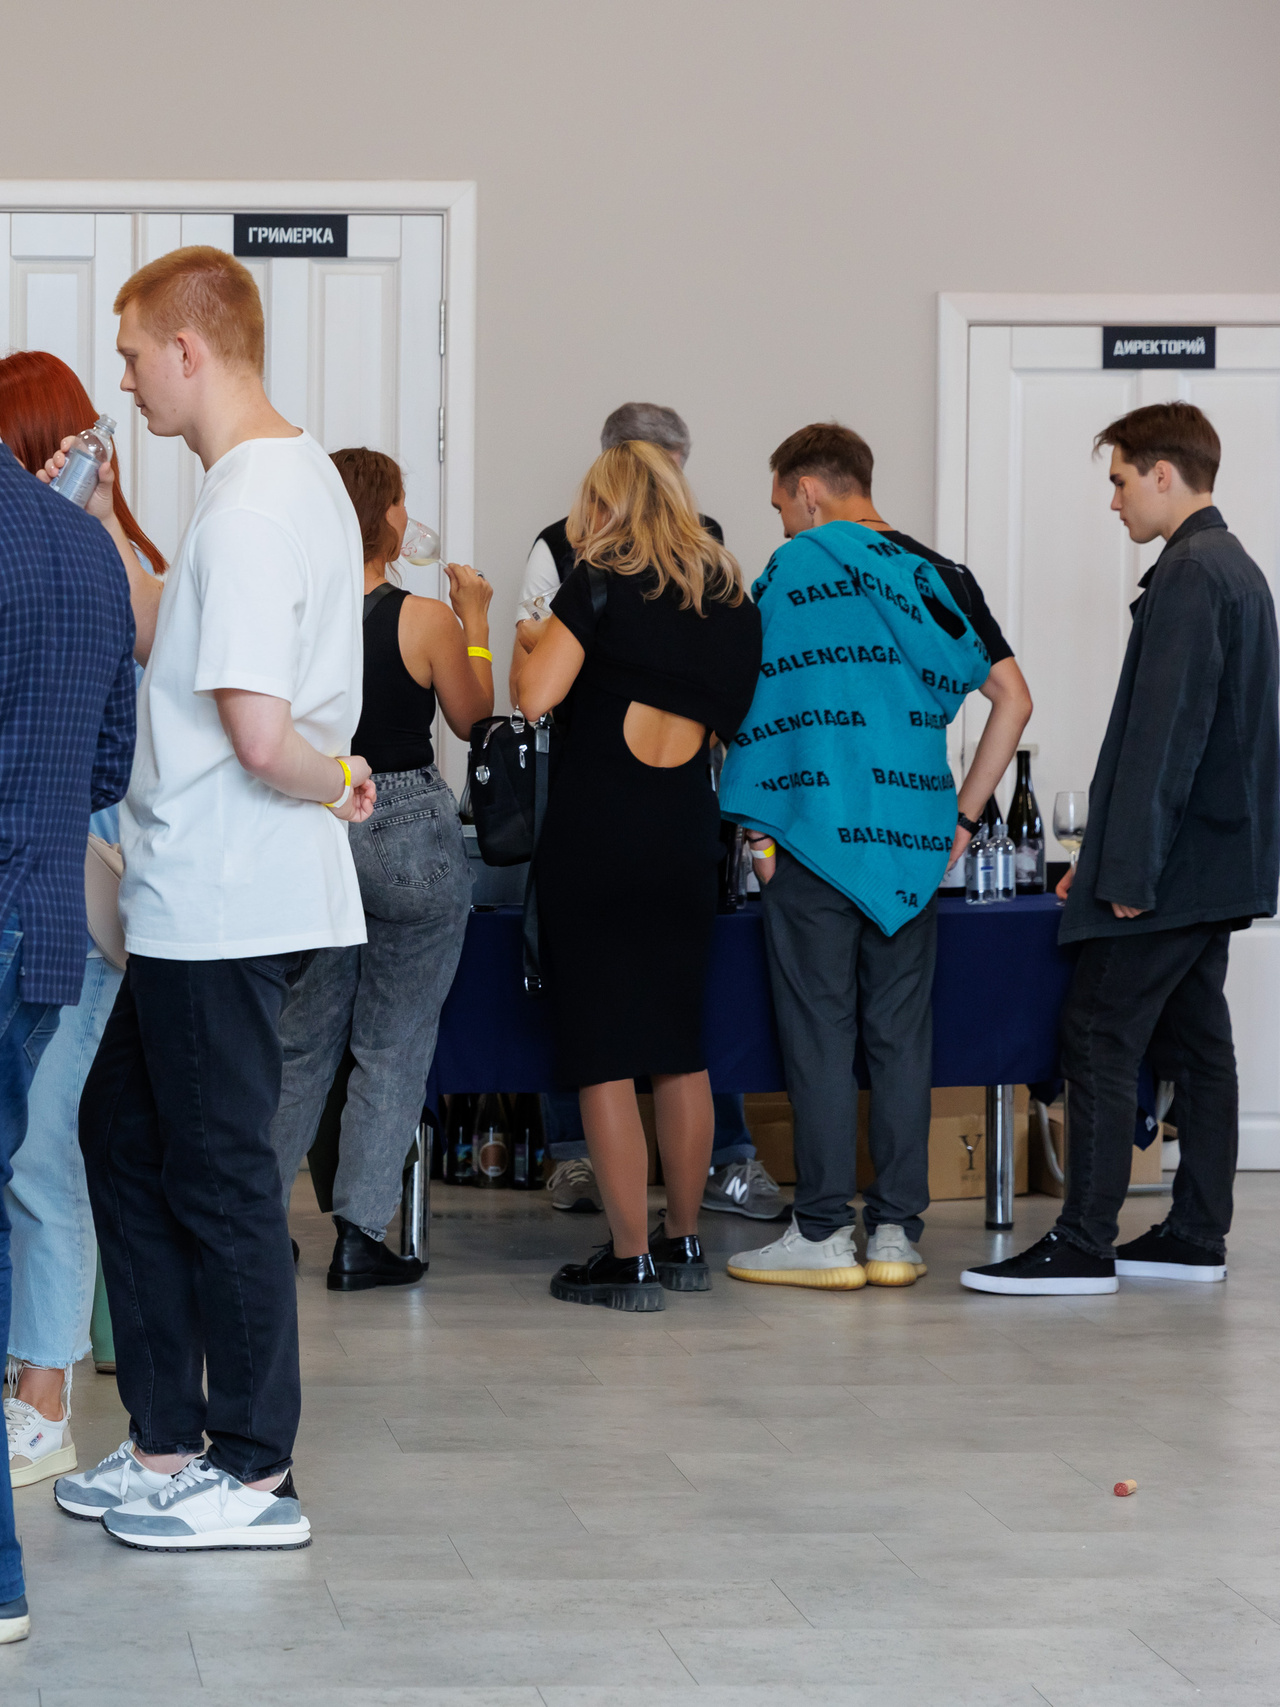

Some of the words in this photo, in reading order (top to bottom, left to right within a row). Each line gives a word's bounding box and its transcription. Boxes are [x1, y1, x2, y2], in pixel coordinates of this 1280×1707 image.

[248, 226, 334, 244] ГРИМЕРКА
[1113, 336, 1206, 356] ДИРЕКТОРИЙ
[761, 645, 903, 679] BALENCIAGA
[733, 709, 867, 748] BALENCIAGA
[755, 770, 831, 792] NCIAGA
